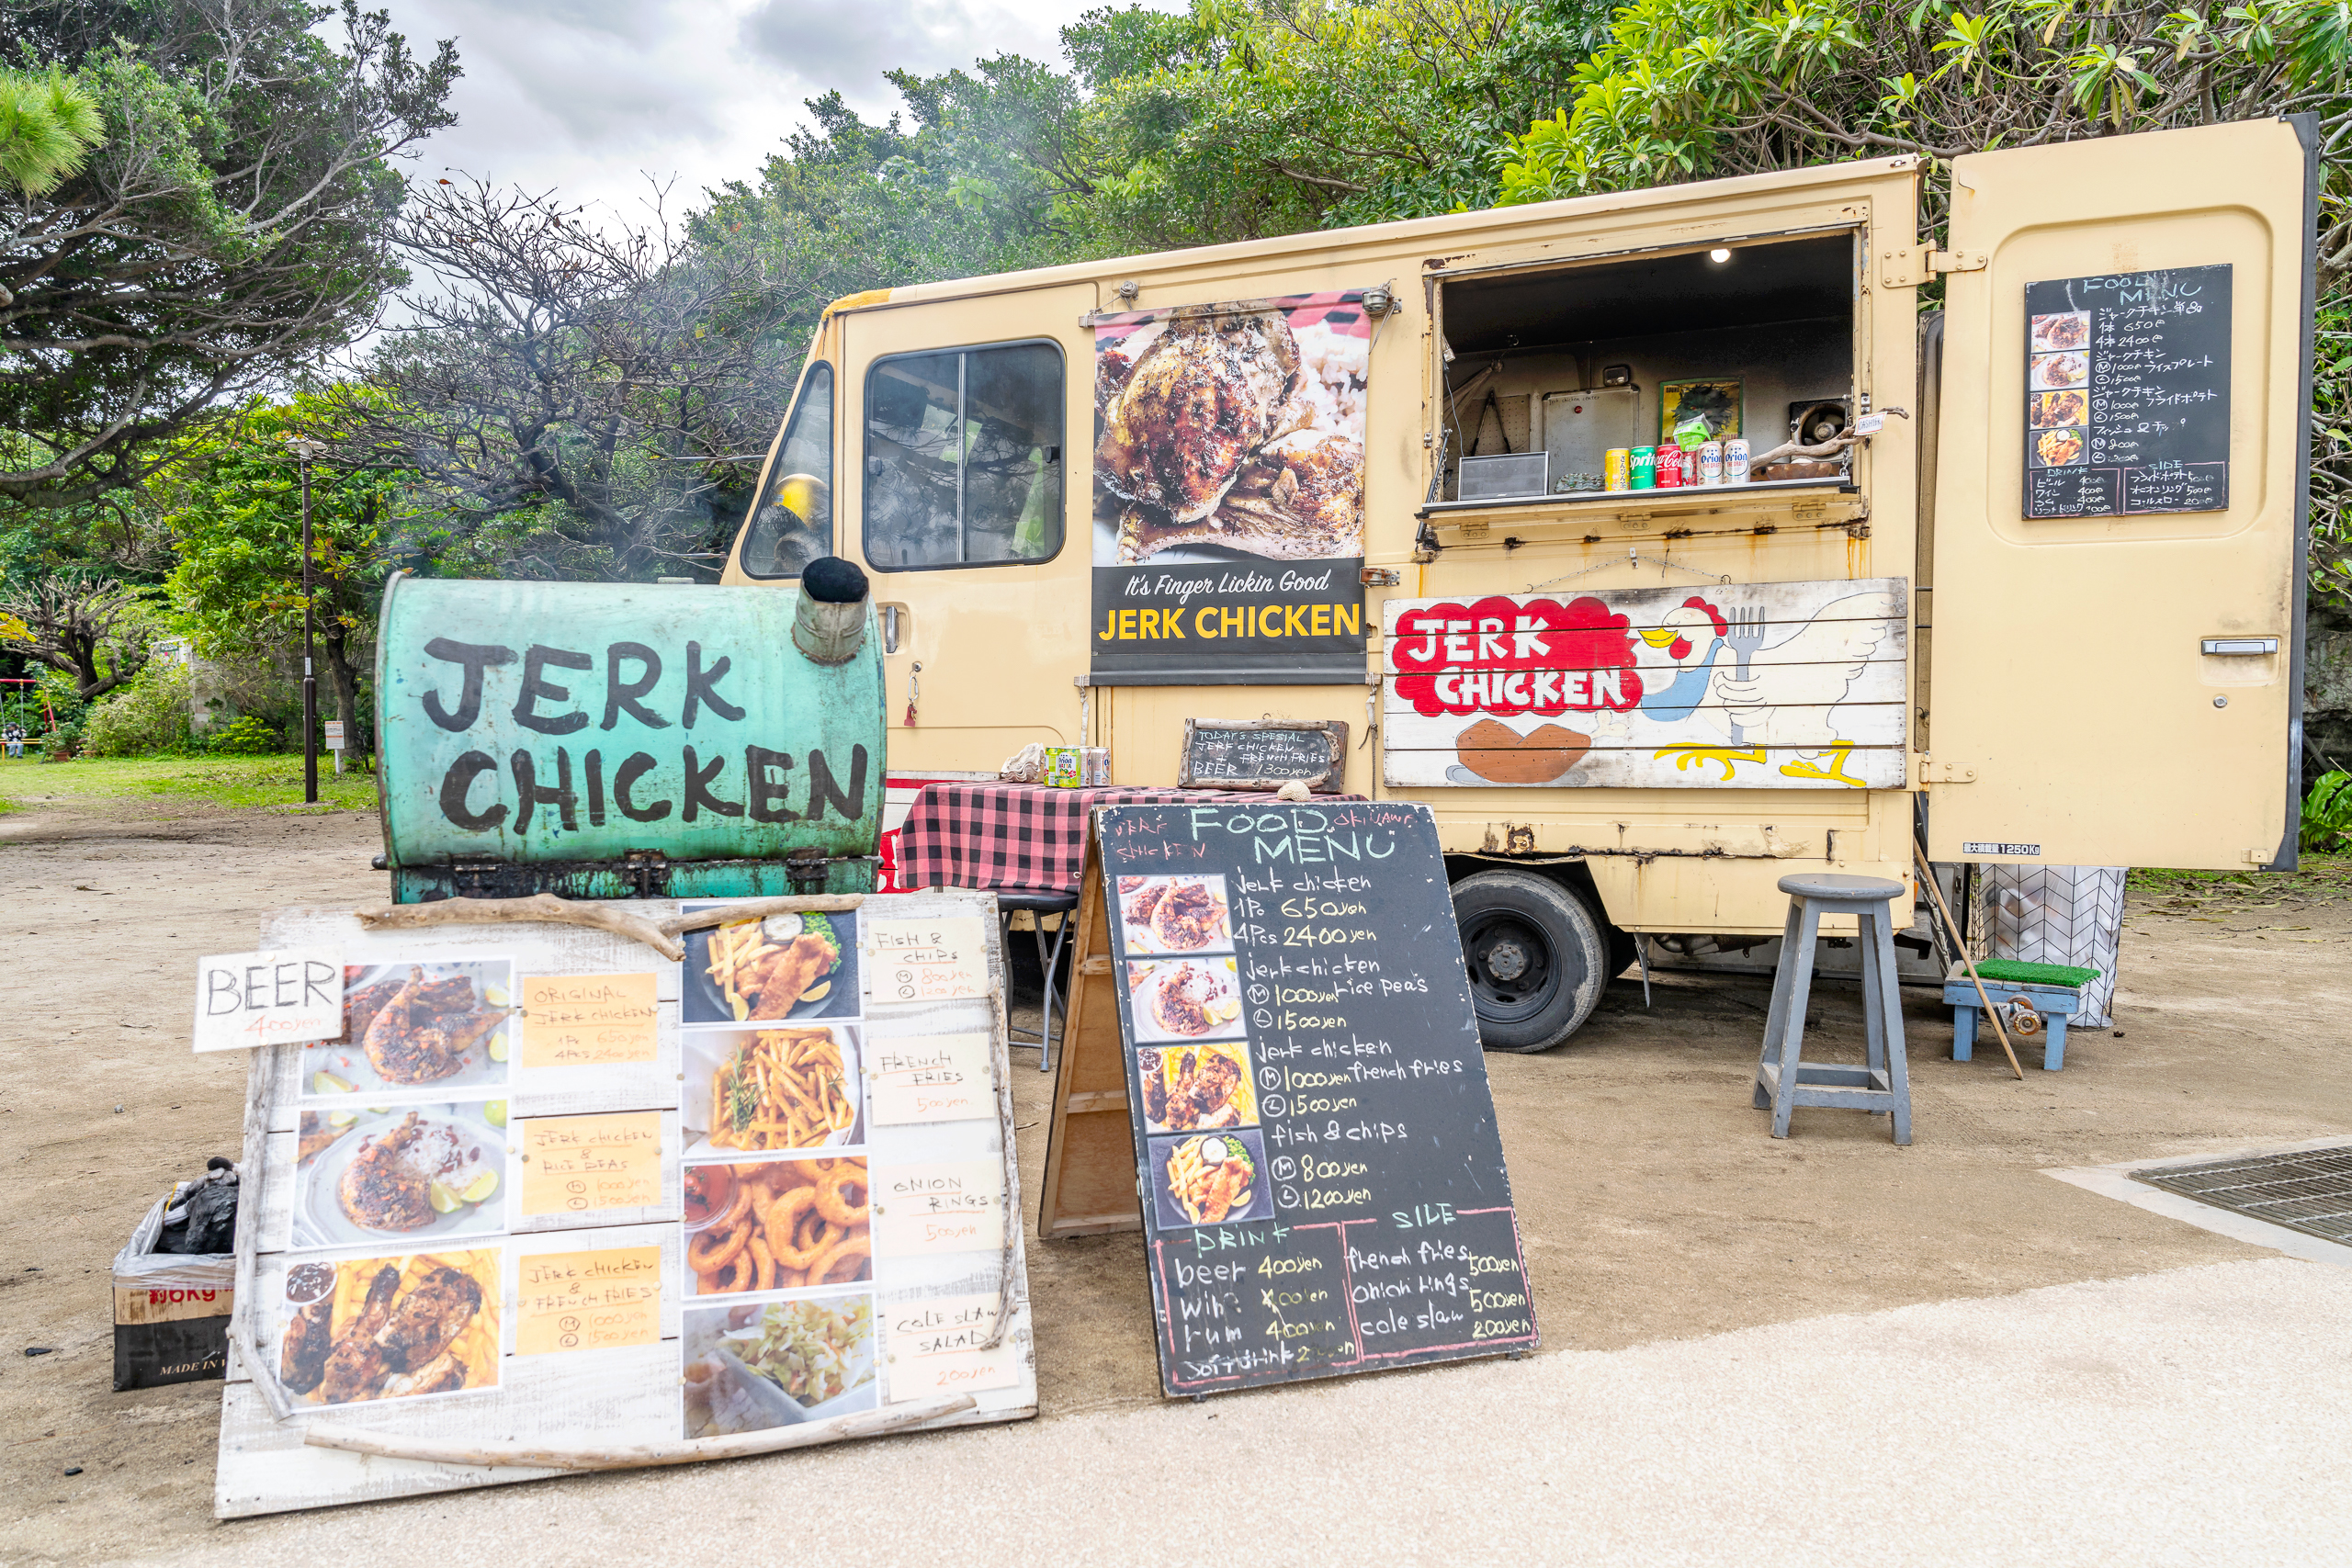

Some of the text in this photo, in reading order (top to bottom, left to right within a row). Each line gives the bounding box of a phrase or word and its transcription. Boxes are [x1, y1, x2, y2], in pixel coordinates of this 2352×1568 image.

[2084, 275, 2154, 293] FOOD
[2120, 282, 2201, 305] MENU
[2096, 348, 2166, 361] ジャークチキン
[2144, 355, 2213, 374] ライスプレート
[2092, 386, 2165, 398] ジャークチキン
[2146, 389, 2218, 407] フライドポテト
[1859, 417, 1882, 430] CASHIER
[1630, 453, 1657, 468] Sprit
[1702, 455, 1723, 463] Orion
[1725, 453, 1747, 461] Orion
[2149, 460, 2183, 469] SIDE
[2037, 479, 2065, 488] ビール
[2036, 489, 2060, 498] ワイン
[1125, 569, 1331, 604] It's Finger Lickin Good
[1098, 604, 1360, 641] JERK CHICKEN
[1408, 615, 1552, 662] JERK
[423, 637, 746, 734] JERK
[1434, 666, 1627, 707] CHICKEN
[1195, 741, 1294, 752] JERK CHICKEN
[1240, 752, 1287, 763] FRENCH
[1291, 752, 1325, 762] FRIES
[1194, 761, 1238, 775] BEER
[439, 743, 868, 835] CHICKEN
[1190, 808, 1328, 840] FOOD
[1254, 831, 1395, 864] MENU
[2001, 845, 2040, 854] 1250Kg
[1294, 865, 1371, 893] chicken
[931, 932, 943, 944] &
[1247, 953, 1380, 980] jerk chicken
[208, 961, 335, 1017] BEER
[535, 986, 627, 1003] ORIGINAL
[1334, 978, 1373, 997] rice
[530, 1005, 652, 1024] JERK CHICKEN
[1256, 1033, 1392, 1063] jerk chicken
[880, 1050, 951, 1072] FRENCH
[1347, 1059, 1407, 1082] french
[1408, 1059, 1464, 1077] fries
[912, 1068, 964, 1086] FRIES
[534, 1127, 652, 1145] JERK CHICKEN
[1272, 1120, 1408, 1147] fish & chips
[581, 1149, 592, 1159] &
[543, 1159, 628, 1174] RICE PEAS
[894, 1177, 961, 1192] ONION
[929, 1195, 988, 1213] RINGS
[1392, 1202, 1456, 1228] SIDE
[1194, 1222, 1290, 1258] DRINK
[1344, 1247, 1411, 1272] french
[1418, 1239, 1468, 1264] fries
[528, 1257, 653, 1283] JERK CHICKEN
[1175, 1258, 1246, 1288] beer
[536, 1285, 652, 1309] FRENCH FRIES
[570, 1282, 582, 1294] &
[1352, 1278, 1411, 1303] onion
[1419, 1272, 1470, 1297] rings
[897, 1311, 944, 1332] COLE
[1361, 1308, 1408, 1336] cole
[1417, 1300, 1464, 1329] slaw
[921, 1330, 988, 1352] SALAD
[1184, 1325, 1242, 1352] rum
[160, 1362, 199, 1375] MADE
[203, 1359, 218, 1370] IN
